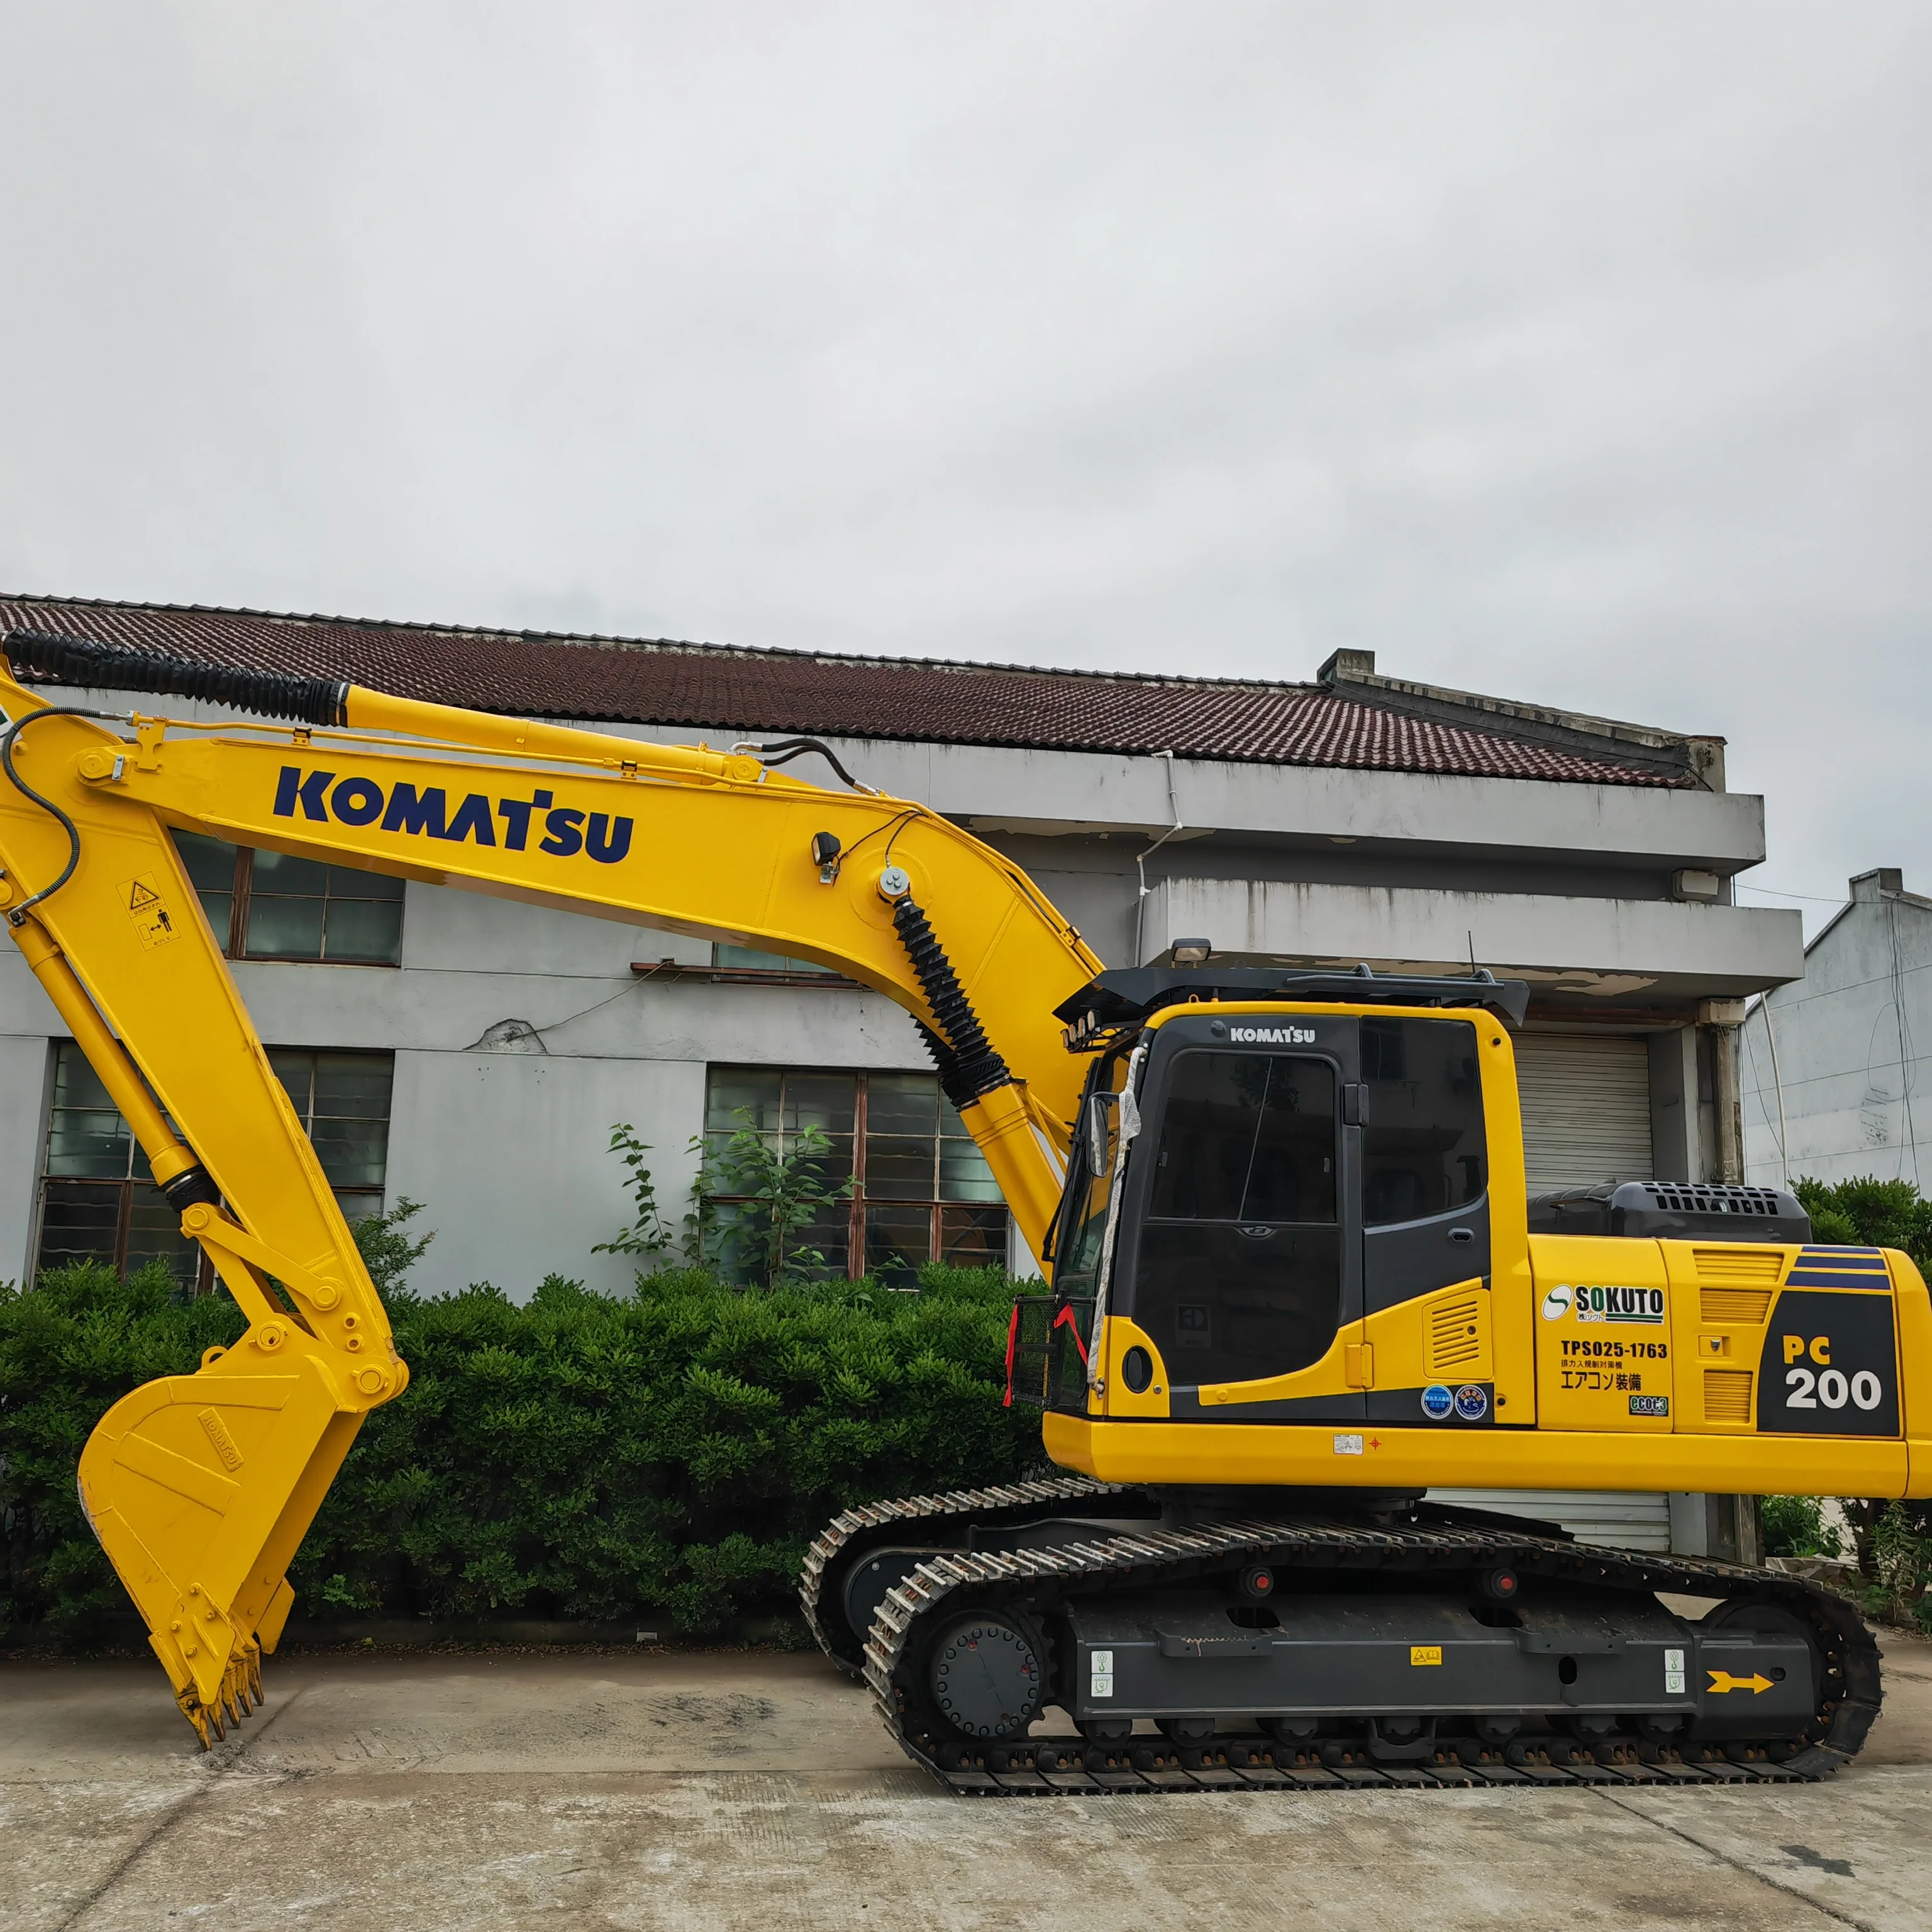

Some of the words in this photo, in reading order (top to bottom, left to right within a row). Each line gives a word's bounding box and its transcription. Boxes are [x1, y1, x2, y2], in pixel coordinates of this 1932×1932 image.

[273, 765, 635, 864] KOMATSU
[1230, 1026, 1316, 1043] KOMATSU
[1575, 1286, 1664, 1314] SOKUTO
[1561, 1340, 1668, 1359] TPS025-1763
[1783, 1335, 1831, 1365] PC
[1631, 1396, 1667, 1411] ecot3
[1785, 1368, 1882, 1411] 200
